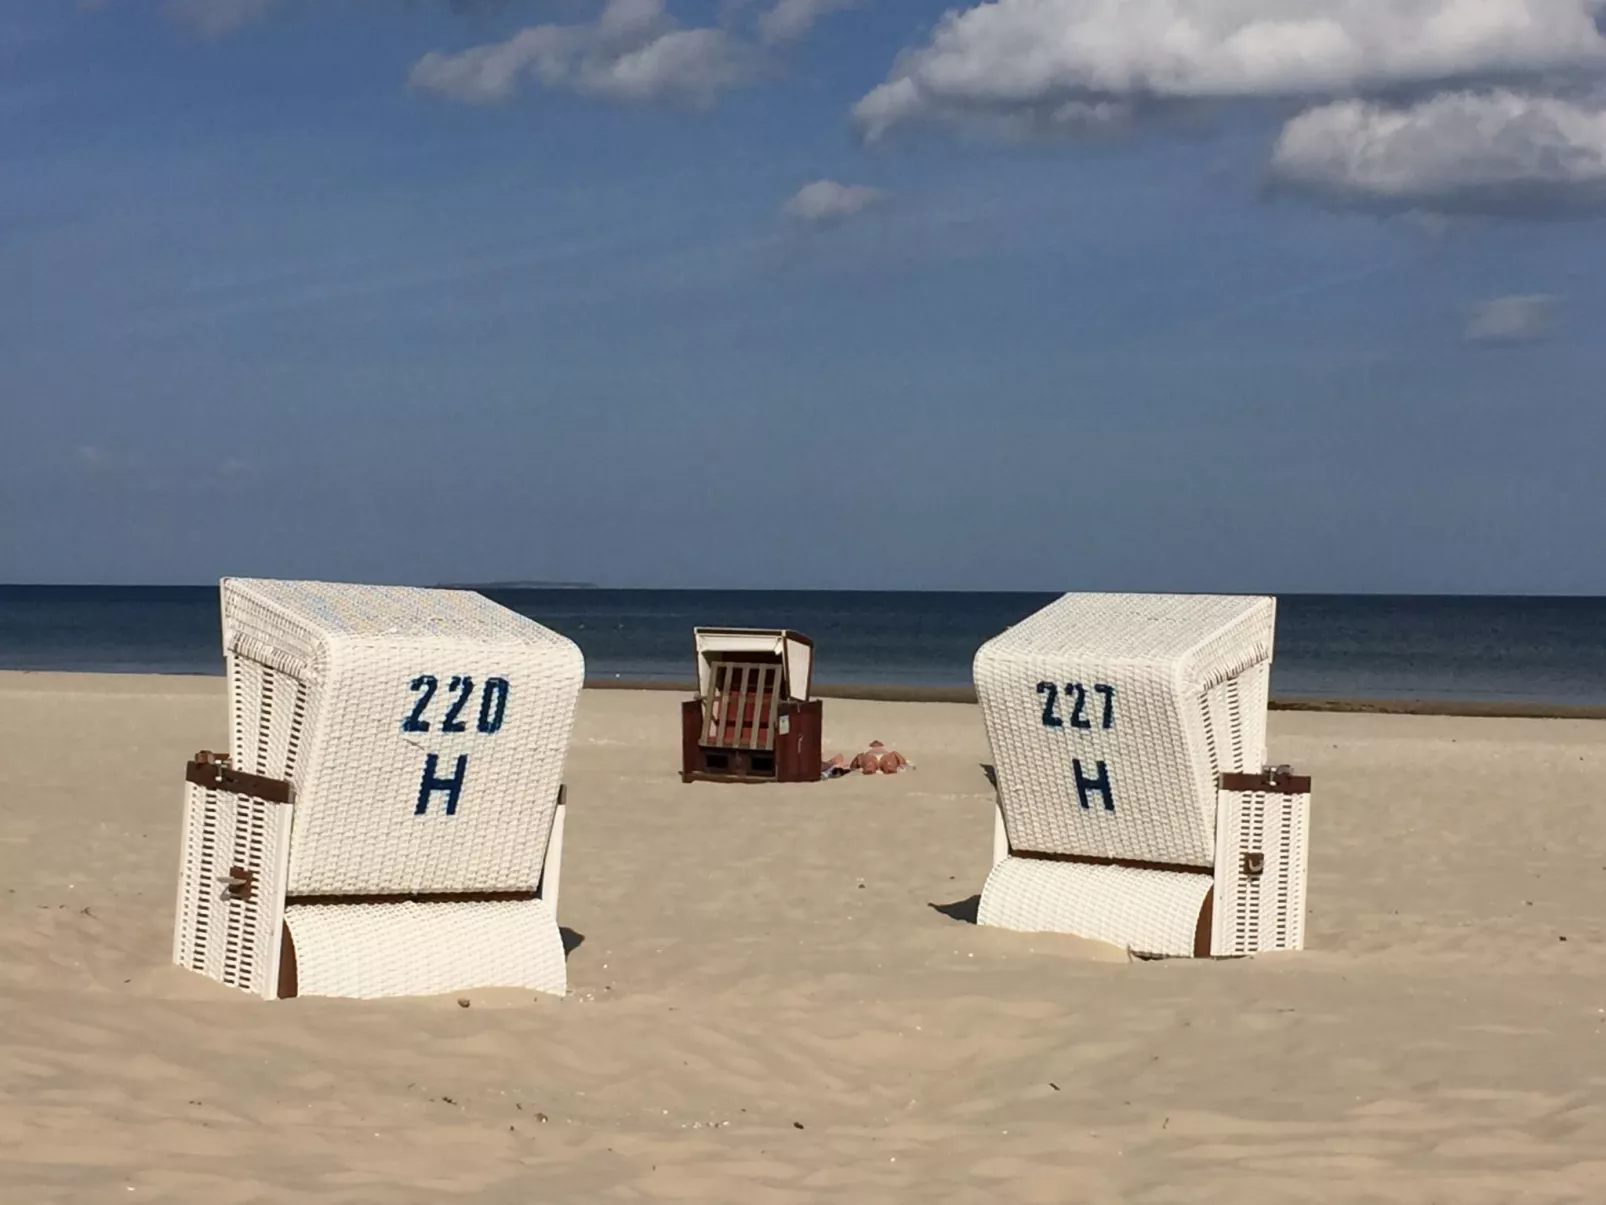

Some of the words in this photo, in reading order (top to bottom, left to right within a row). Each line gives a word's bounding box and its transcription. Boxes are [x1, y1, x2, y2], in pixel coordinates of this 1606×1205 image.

[402, 675, 511, 735] 220
[1035, 680, 1117, 731] 227
[414, 752, 468, 816] H
[1072, 758, 1116, 814] H
